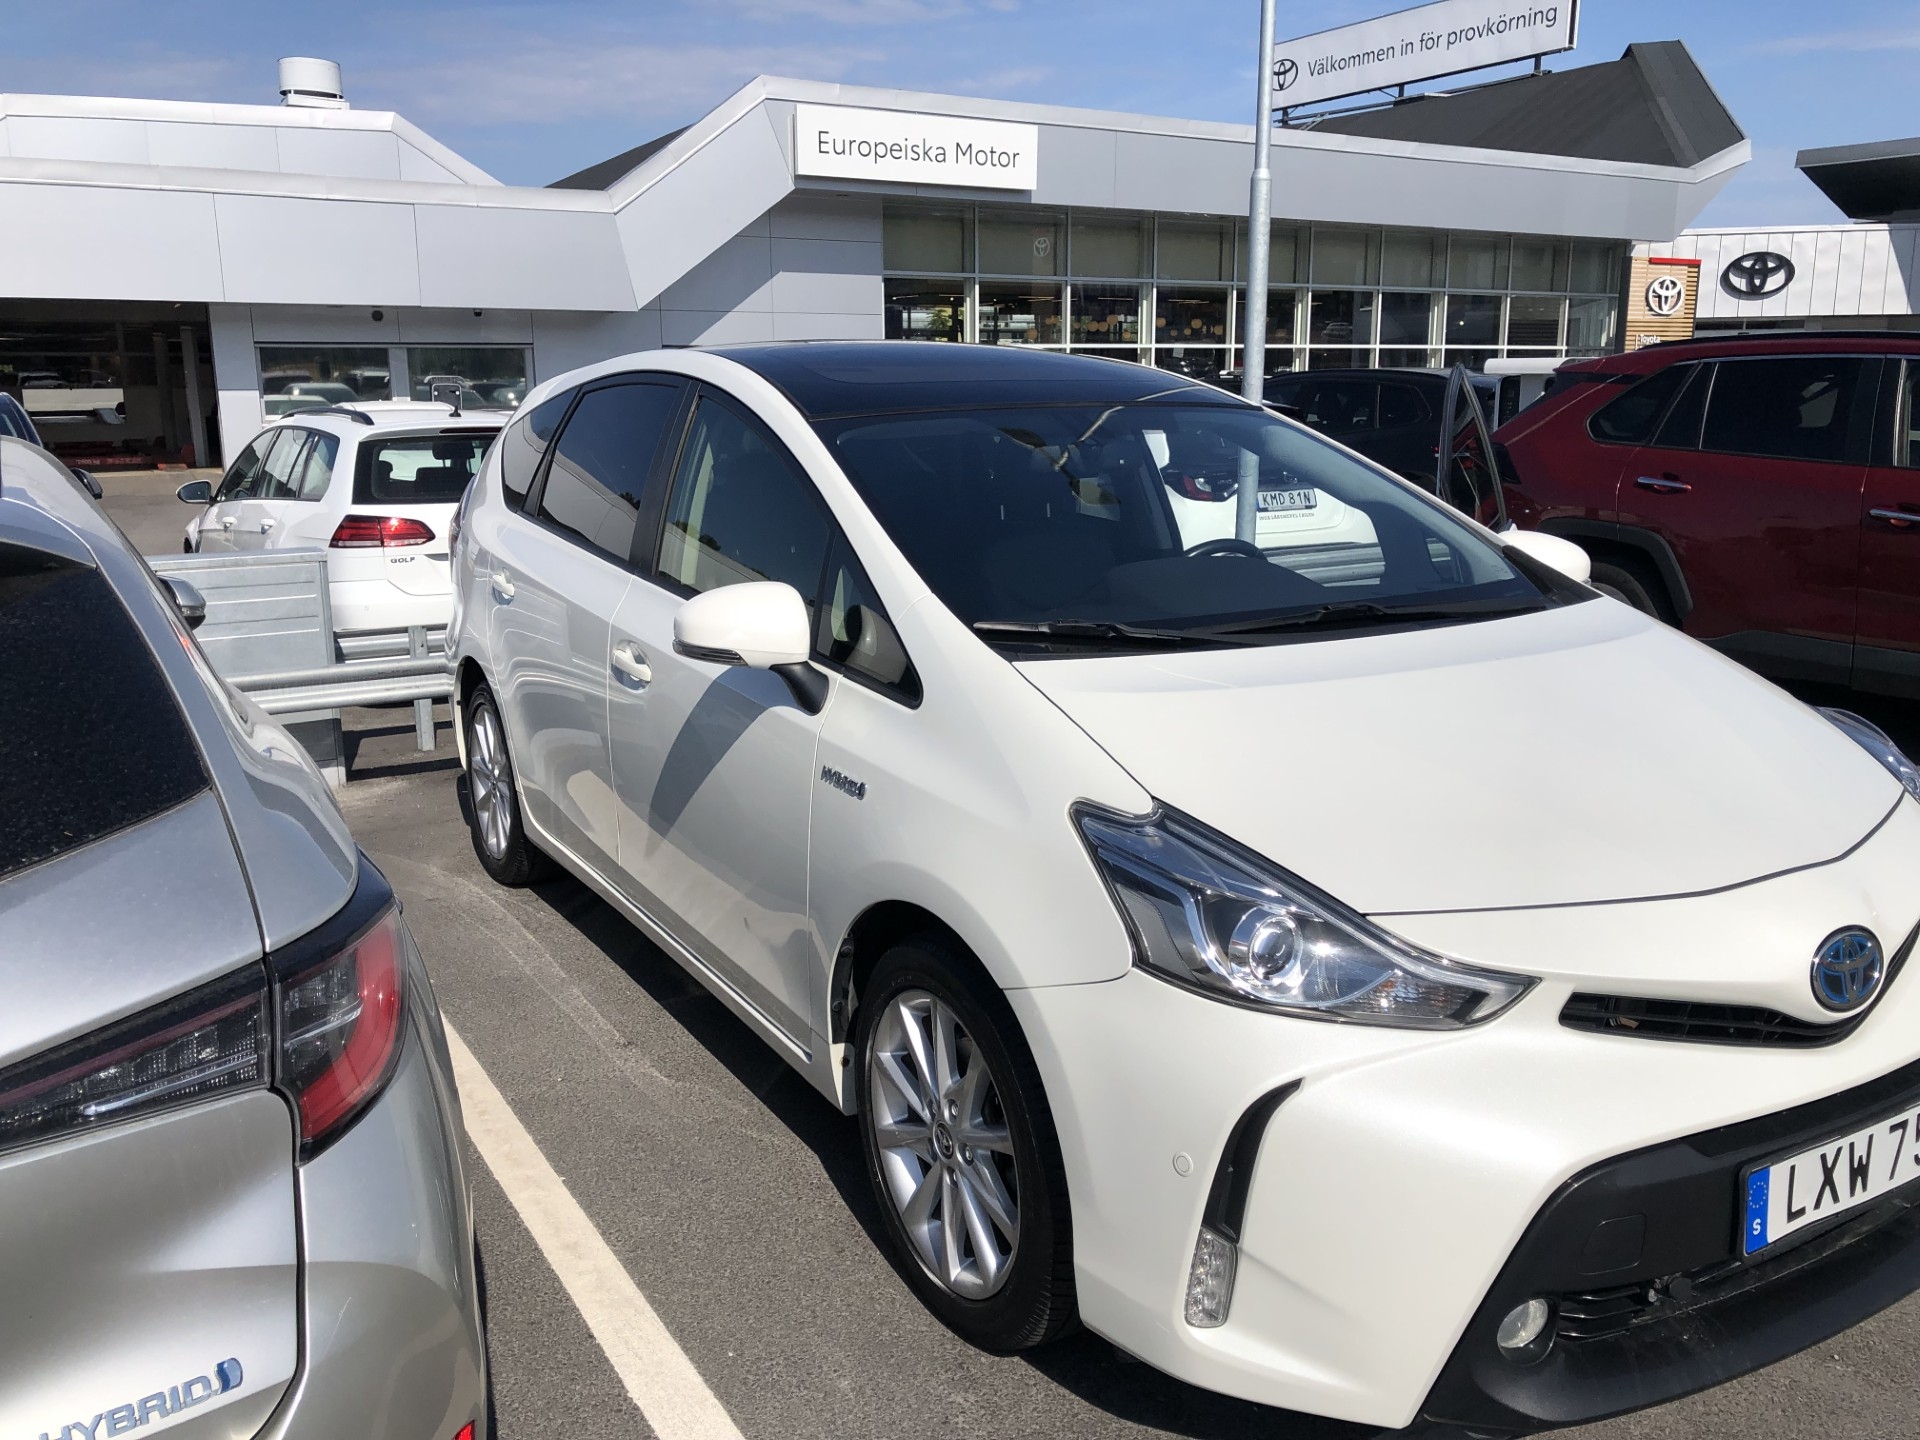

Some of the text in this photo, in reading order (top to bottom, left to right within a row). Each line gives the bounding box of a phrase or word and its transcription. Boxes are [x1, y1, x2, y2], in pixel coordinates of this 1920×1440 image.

[1307, 6, 1559, 78] Välkommen in för provkörning
[818, 130, 1020, 168] Europeiska Motor
[1640, 334, 1661, 346] Toyota
[1262, 491, 1311, 506] KMD 81N
[1787, 1133, 1874, 1224] LXW
[1752, 1218, 1761, 1235] S
